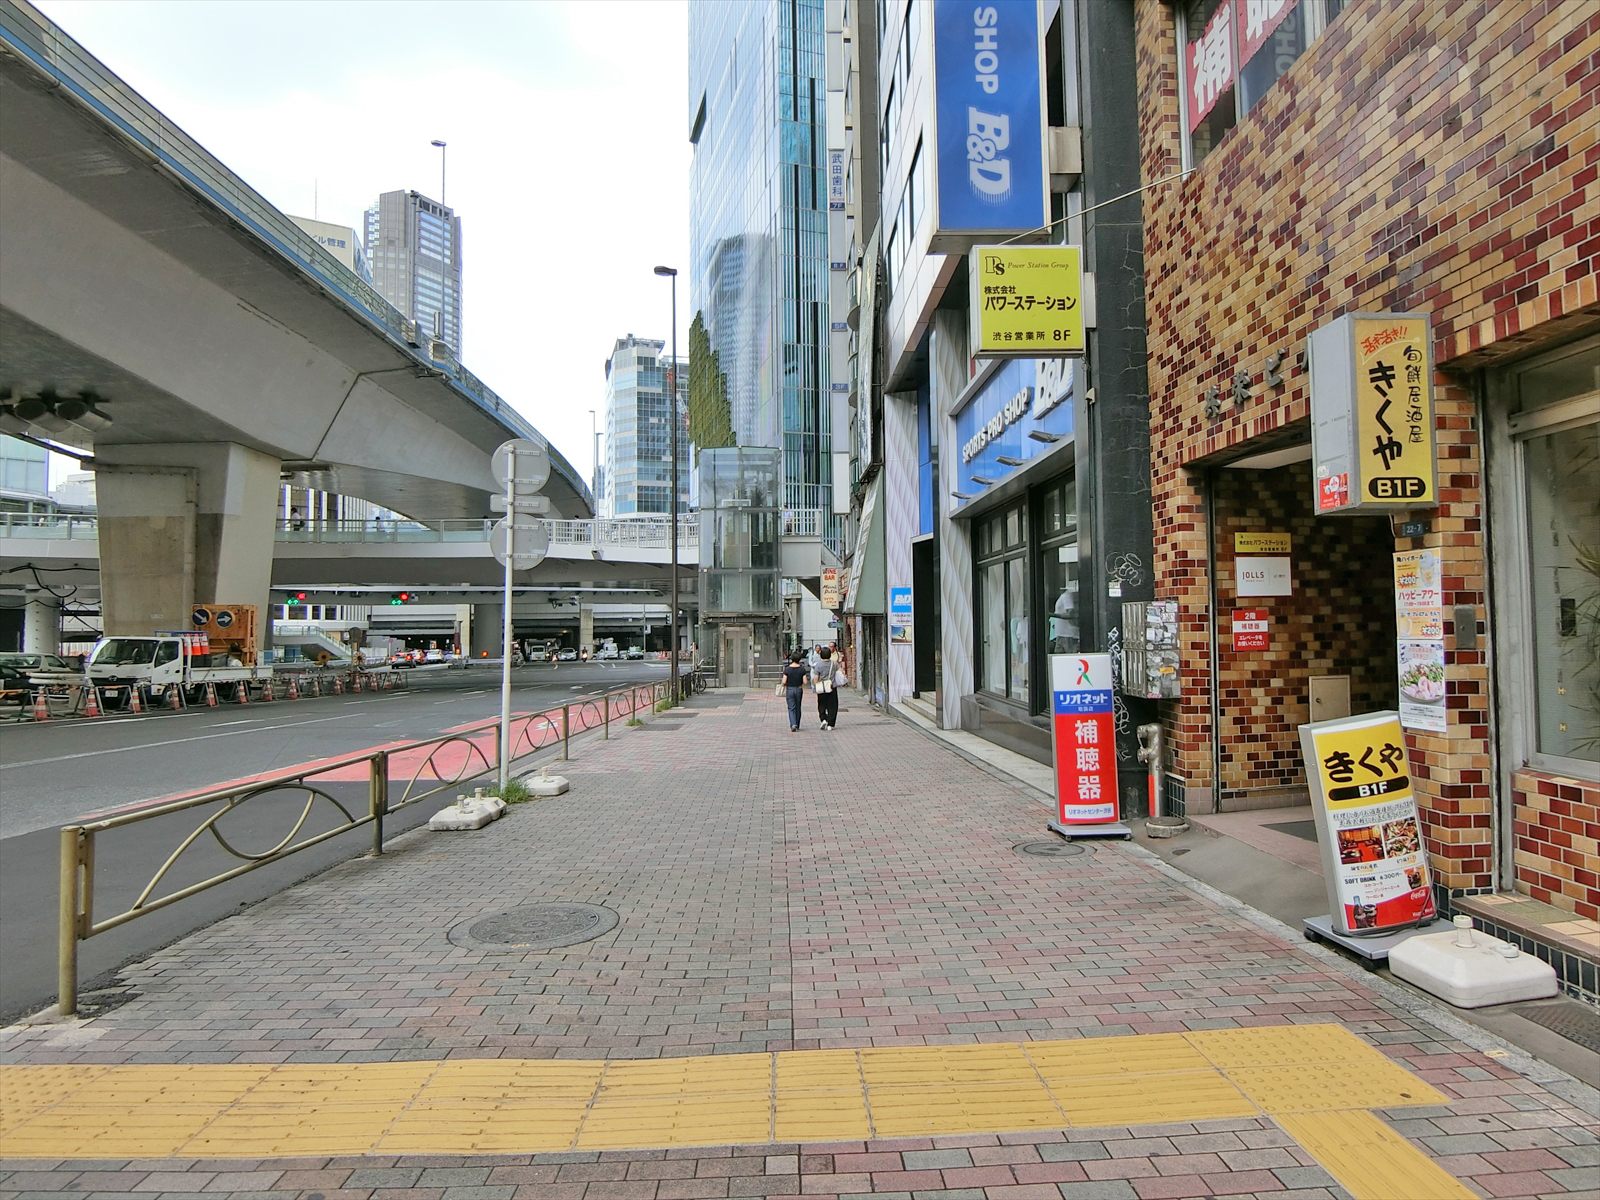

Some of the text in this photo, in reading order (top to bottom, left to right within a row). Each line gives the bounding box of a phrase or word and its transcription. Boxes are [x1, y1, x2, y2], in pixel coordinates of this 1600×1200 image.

[967, 6, 1010, 204] SHOP B&D
[832, 153, 842, 197] 武田歯科
[1051, 262, 1069, 271] Group
[984, 285, 1016, 295] 株式会社
[984, 296, 1077, 311] パワーステーション
[992, 329, 1071, 341] 渋谷営業所 8F
[1204, 340, 1309, 419] 共栄ビ
[1403, 345, 1425, 443] 旬鮮居酒屋
[1369, 361, 1402, 470] きくや
[962, 426, 987, 464] SPORTS
[987, 410, 1004, 441] PRO
[1004, 386, 1031, 425] SHOP
[1377, 479, 1419, 497] B1F
[1242, 571, 1265, 580] JOLLS
[1398, 590, 1440, 600] ハッピーアワー
[1060, 693, 1108, 705] リオネット
[1074, 720, 1102, 800] 補聴器
[1324, 743, 1403, 782] きくや
[1358, 781, 1388, 797] B1F
